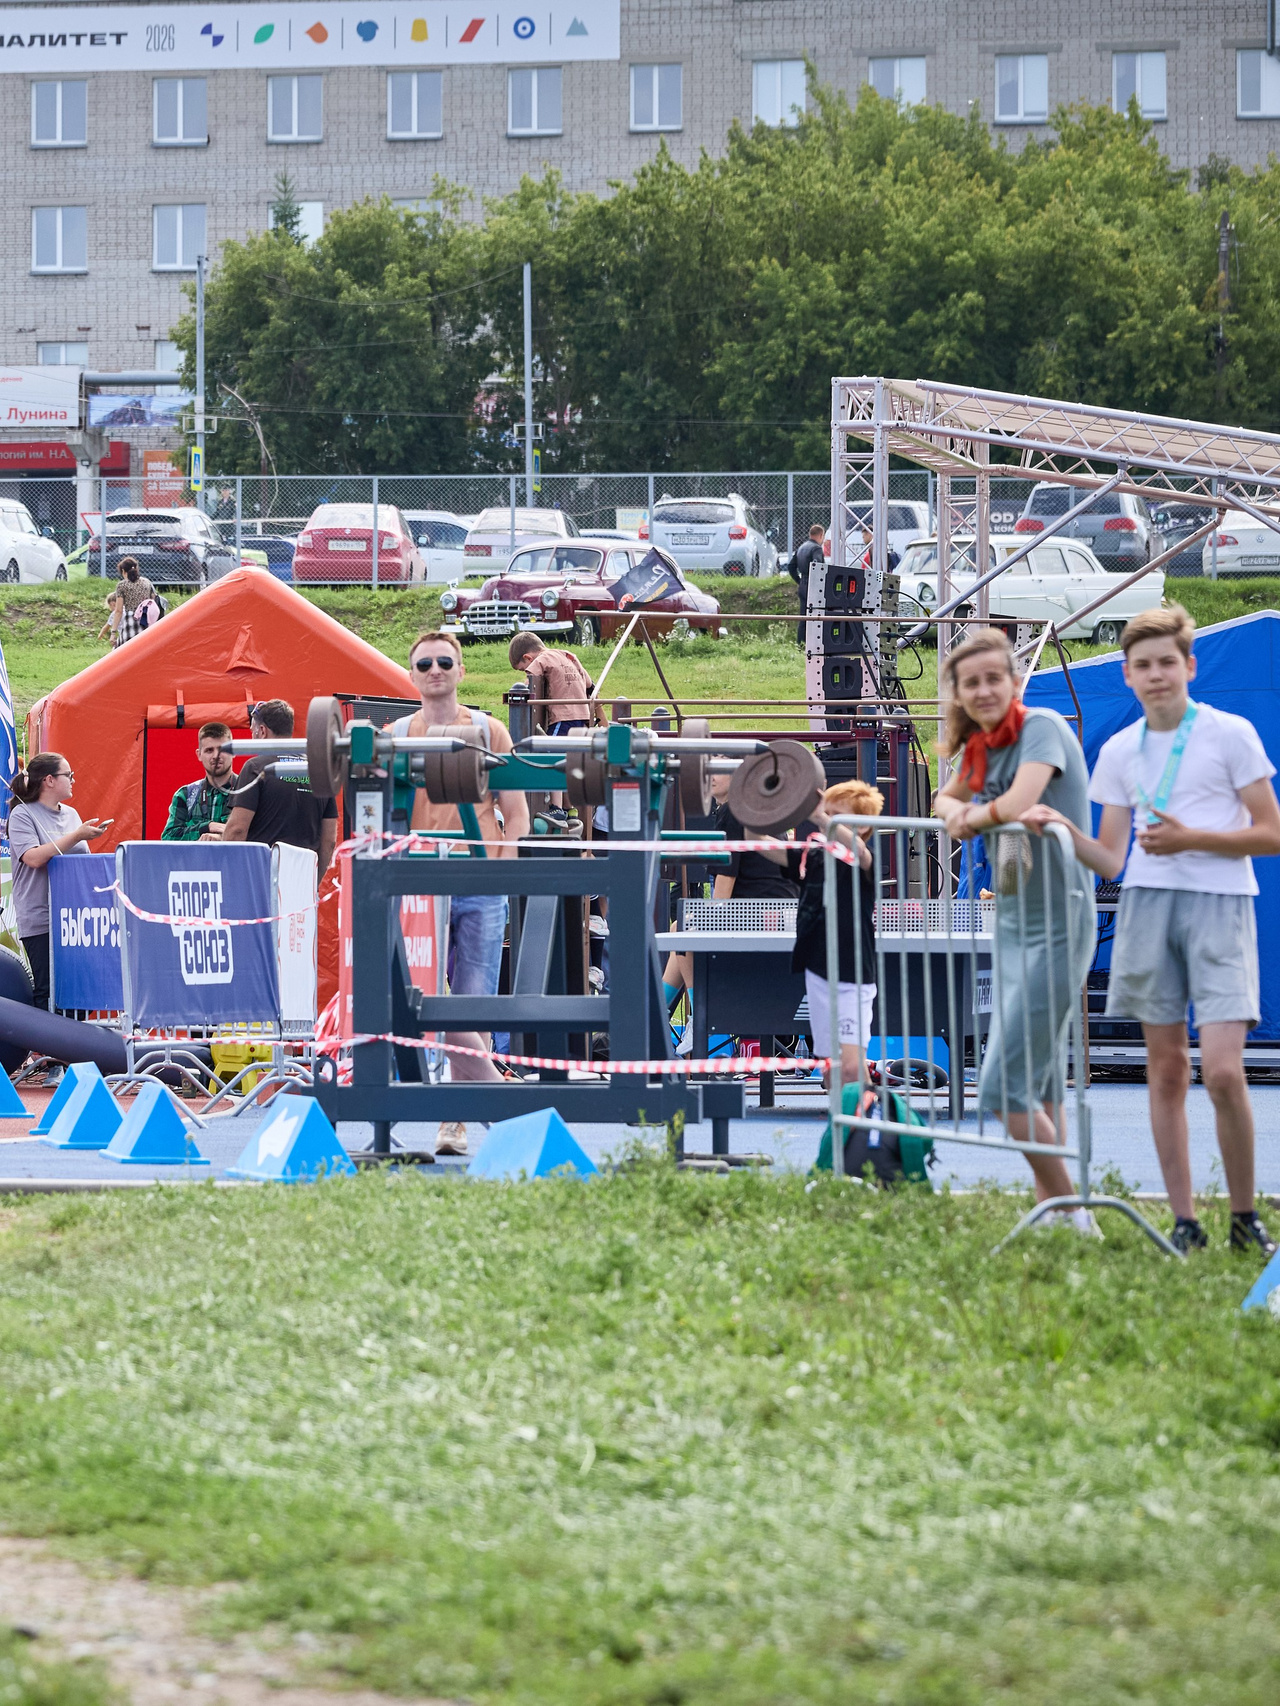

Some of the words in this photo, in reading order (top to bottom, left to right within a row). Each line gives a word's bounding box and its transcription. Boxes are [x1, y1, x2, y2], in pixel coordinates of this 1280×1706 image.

[146, 24, 175, 52] 2026
[7, 407, 68, 423] Лунина
[29, 452, 46, 460] им.
[171, 882, 219, 921] СПОРТ
[183, 929, 230, 974] СОЮЗ
